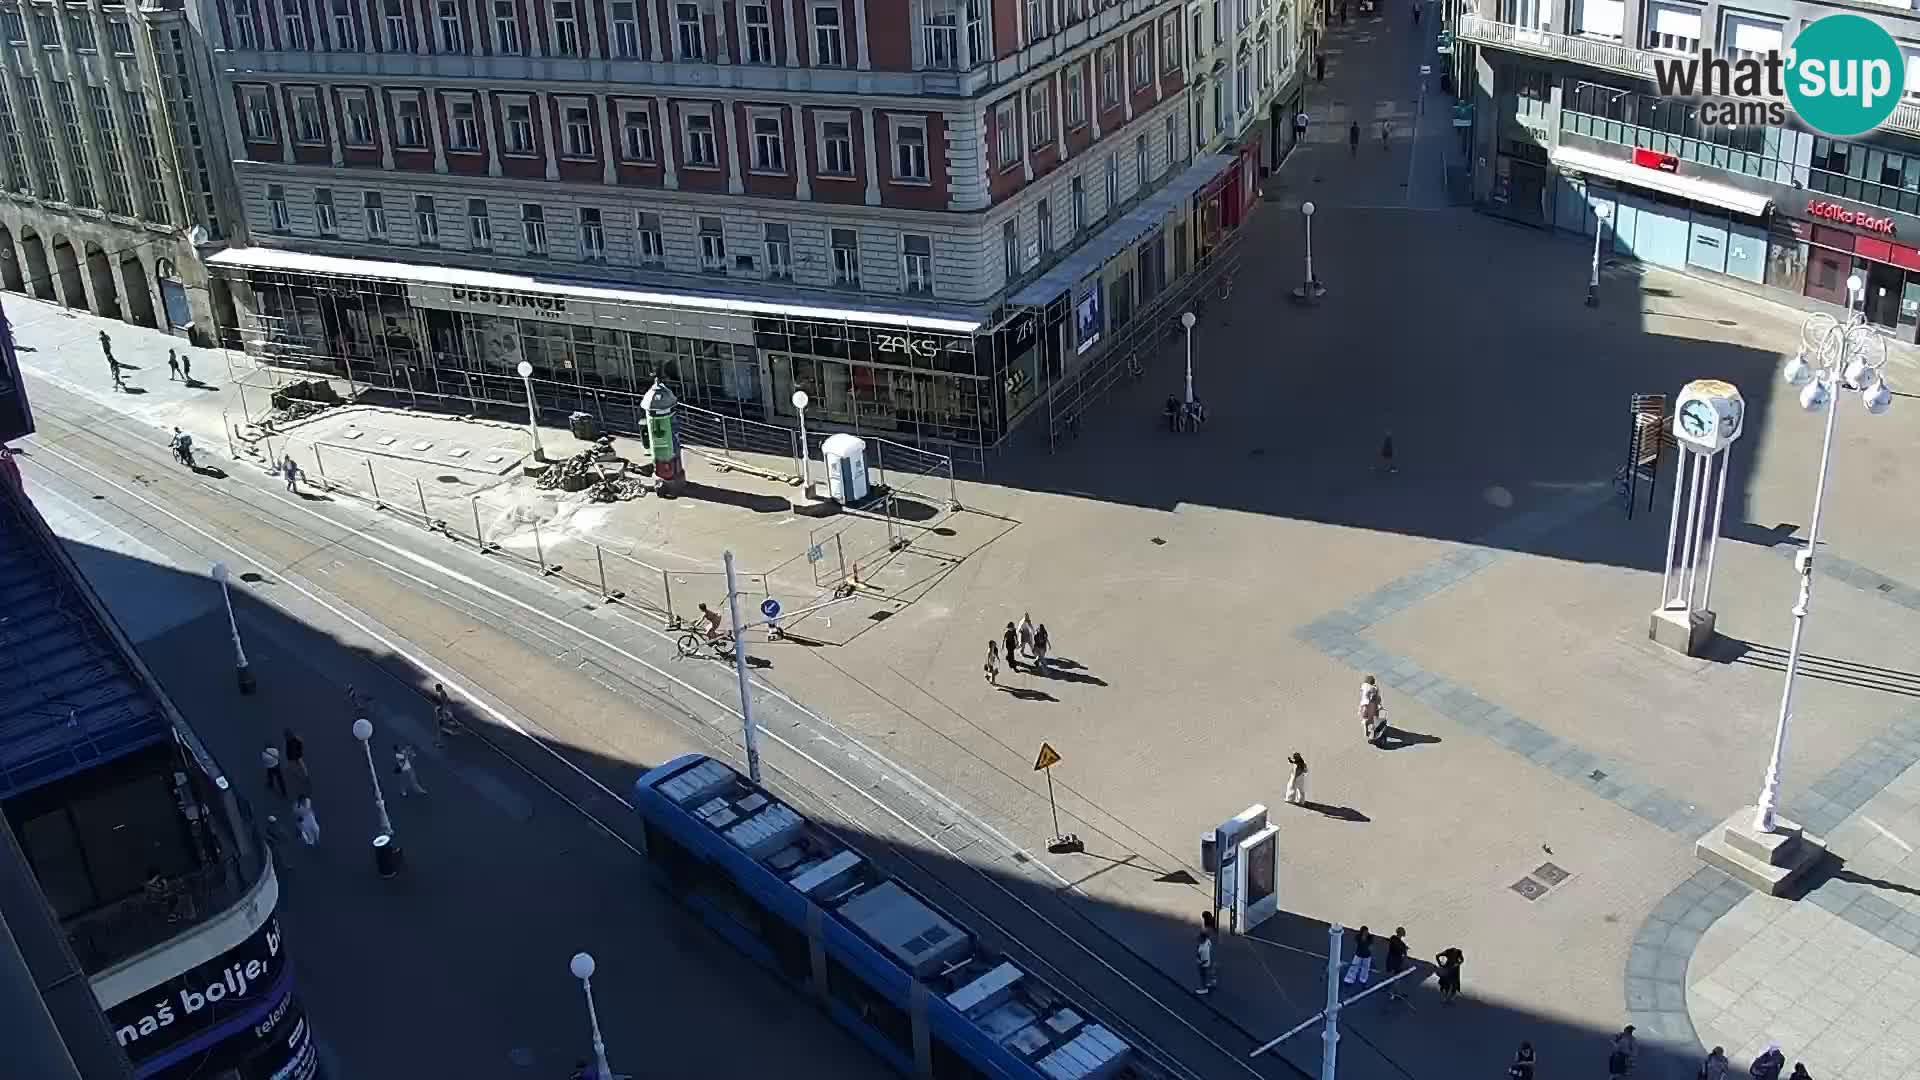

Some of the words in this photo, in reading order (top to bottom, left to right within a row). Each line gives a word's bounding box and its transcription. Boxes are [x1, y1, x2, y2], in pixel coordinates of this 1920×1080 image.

[1856, 212, 1894, 233] Bank
[877, 334, 937, 357] ZAKS
[115, 999, 176, 1047] naš
[179, 959, 268, 1015] bolje,
